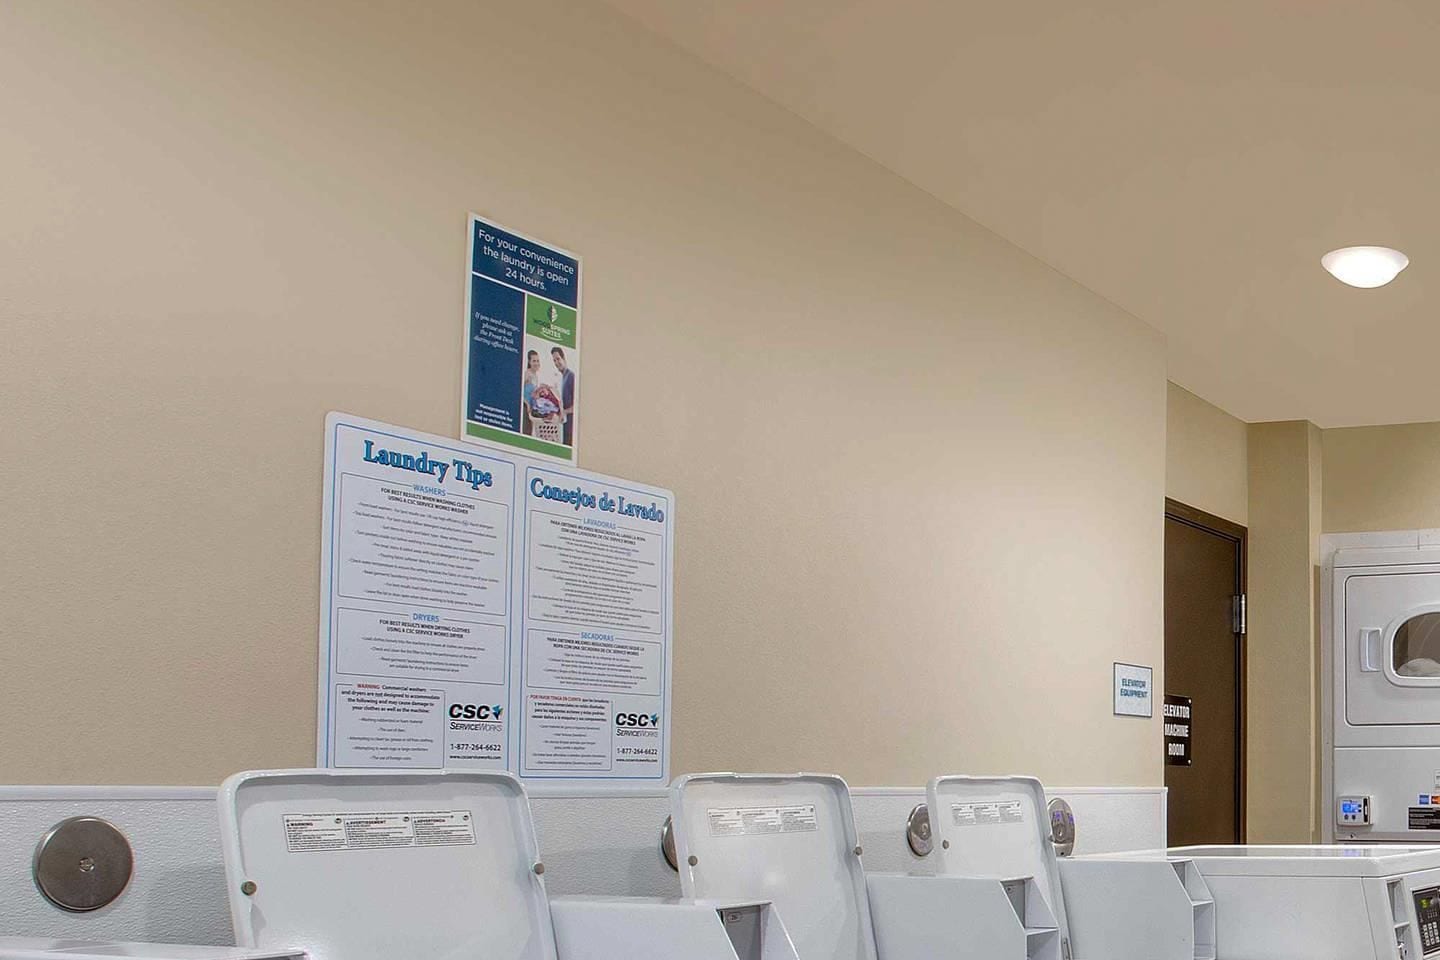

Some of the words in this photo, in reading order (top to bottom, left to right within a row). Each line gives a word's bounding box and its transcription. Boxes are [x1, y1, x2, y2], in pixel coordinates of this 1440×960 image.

[478, 229, 495, 243] For
[497, 238, 518, 252] your
[520, 248, 574, 274] convenience
[483, 246, 499, 259] the
[501, 252, 536, 274] laundry
[536, 264, 544, 276] is
[546, 272, 568, 286] open
[506, 268, 517, 280] 24
[520, 273, 547, 290] hours.
[363, 439, 450, 484] Laundry
[452, 458, 493, 490] Tips
[413, 484, 446, 497] WASHERS
[530, 477, 597, 511] Consejos
[598, 492, 616, 513] de
[617, 496, 665, 523] Lavado
[583, 518, 617, 530] LAVADORAS
[412, 612, 440, 623] DRYERS
[580, 632, 614, 642] SECADORAS
[1122, 678, 1146, 688] ELEVATOR
[1120, 688, 1148, 698] EQUIPMENT
[448, 704, 490, 720] CSC
[1164, 704, 1190, 719] ELEVATOR
[616, 713, 648, 726] CSC
[450, 722, 502, 731] SERVICEWORKS
[616, 728, 658, 738] SERVICEWORKS
[1164, 724, 1189, 737] MACHINE
[450, 743, 501, 752] 1-877-264-6622
[617, 748, 658, 756] 1-877-264-6622
[1168, 743, 1184, 756] ROOM
